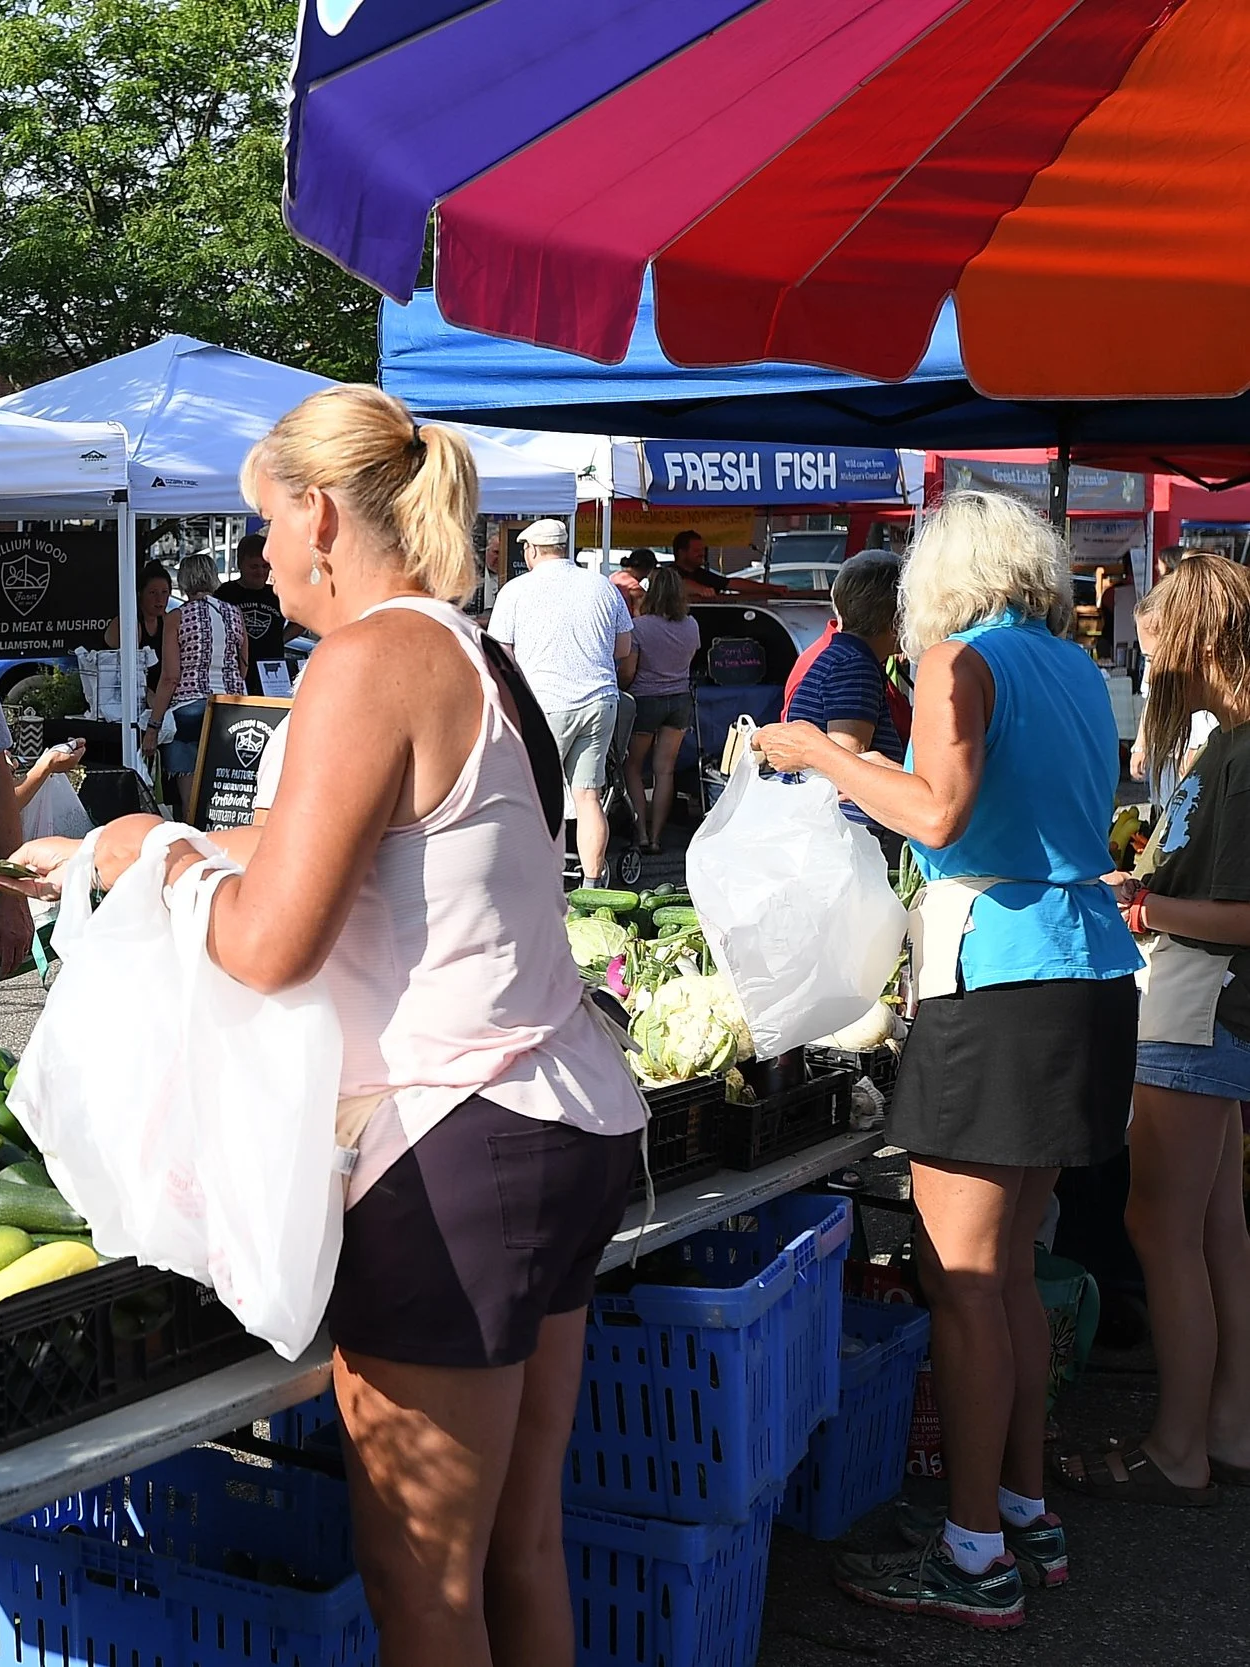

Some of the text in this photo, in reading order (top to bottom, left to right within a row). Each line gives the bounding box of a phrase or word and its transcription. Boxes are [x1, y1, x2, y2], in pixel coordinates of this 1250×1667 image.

[664, 452, 837, 491] FRESH FISH
[992, 468, 1016, 483] Great
[1017, 469, 1040, 484] Lakes
[35, 539, 68, 564] WOOD
[12, 620, 44, 633] MEAT
[46, 620, 53, 631] &
[52, 639, 64, 648] MI
